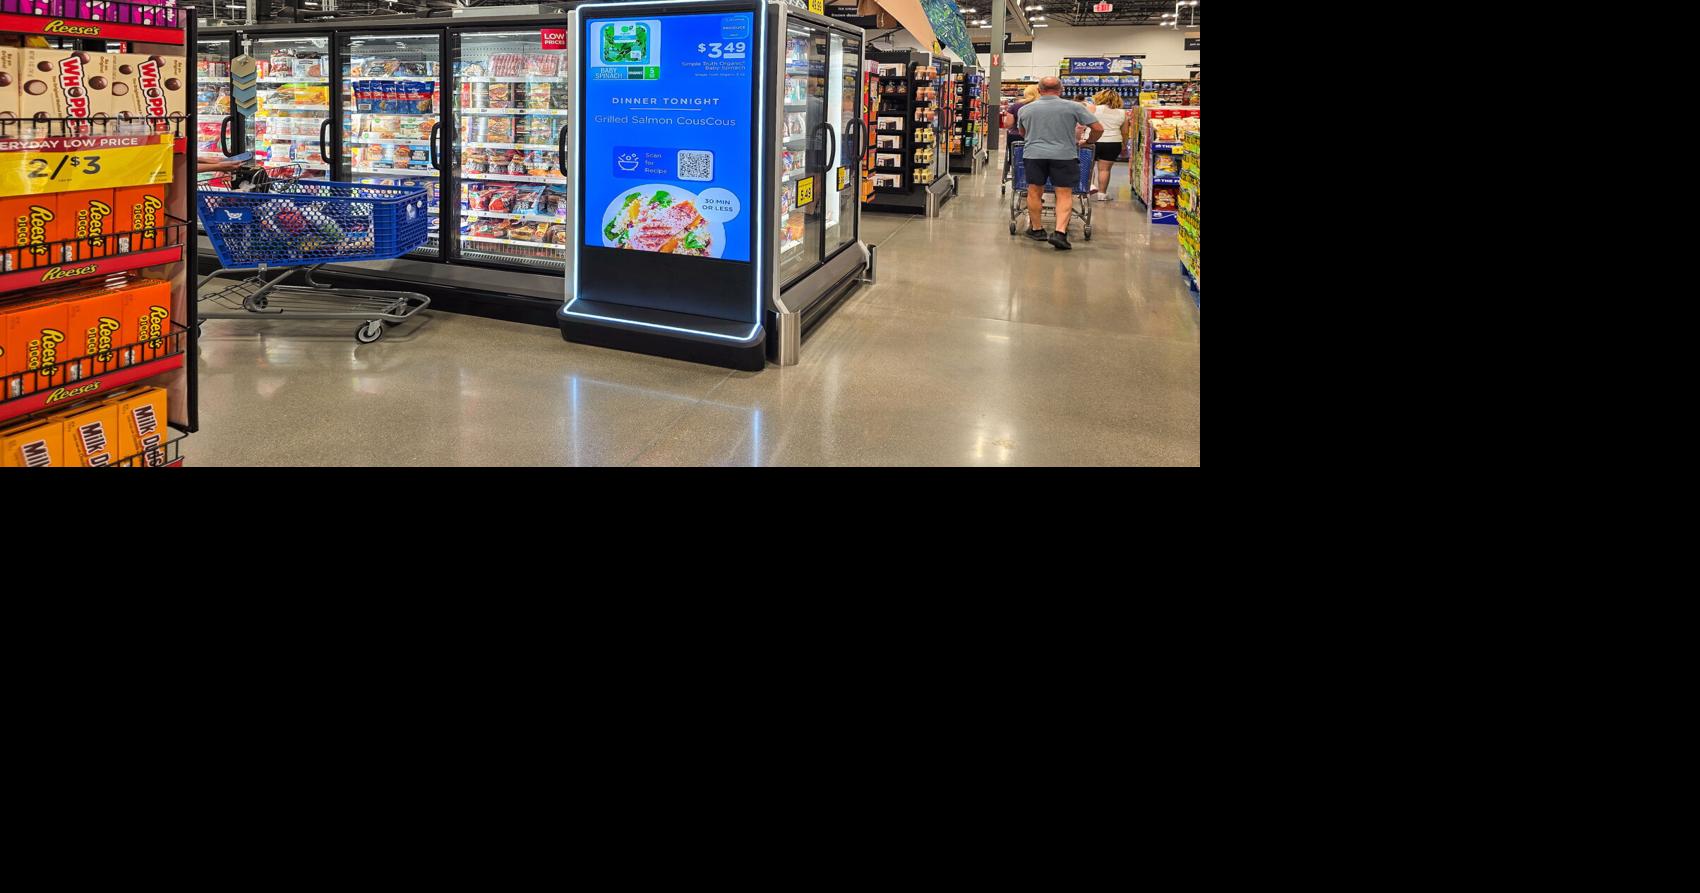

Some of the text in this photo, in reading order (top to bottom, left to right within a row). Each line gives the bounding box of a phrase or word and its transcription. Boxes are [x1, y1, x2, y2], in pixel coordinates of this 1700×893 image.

[44, 19, 101, 36] Reese's
[612, 97, 657, 105] DINNER
[595, 115, 736, 126] Grilled Salmon CousCous
[64, 139, 95, 148] LOW
[101, 138, 138, 146] PRICE
[41, 264, 98, 282] Reese's
[46, 381, 101, 404] Reese's
[133, 404, 157, 436] Milk
[80, 421, 106, 455] Milk
[21, 440, 50, 467] Mil
